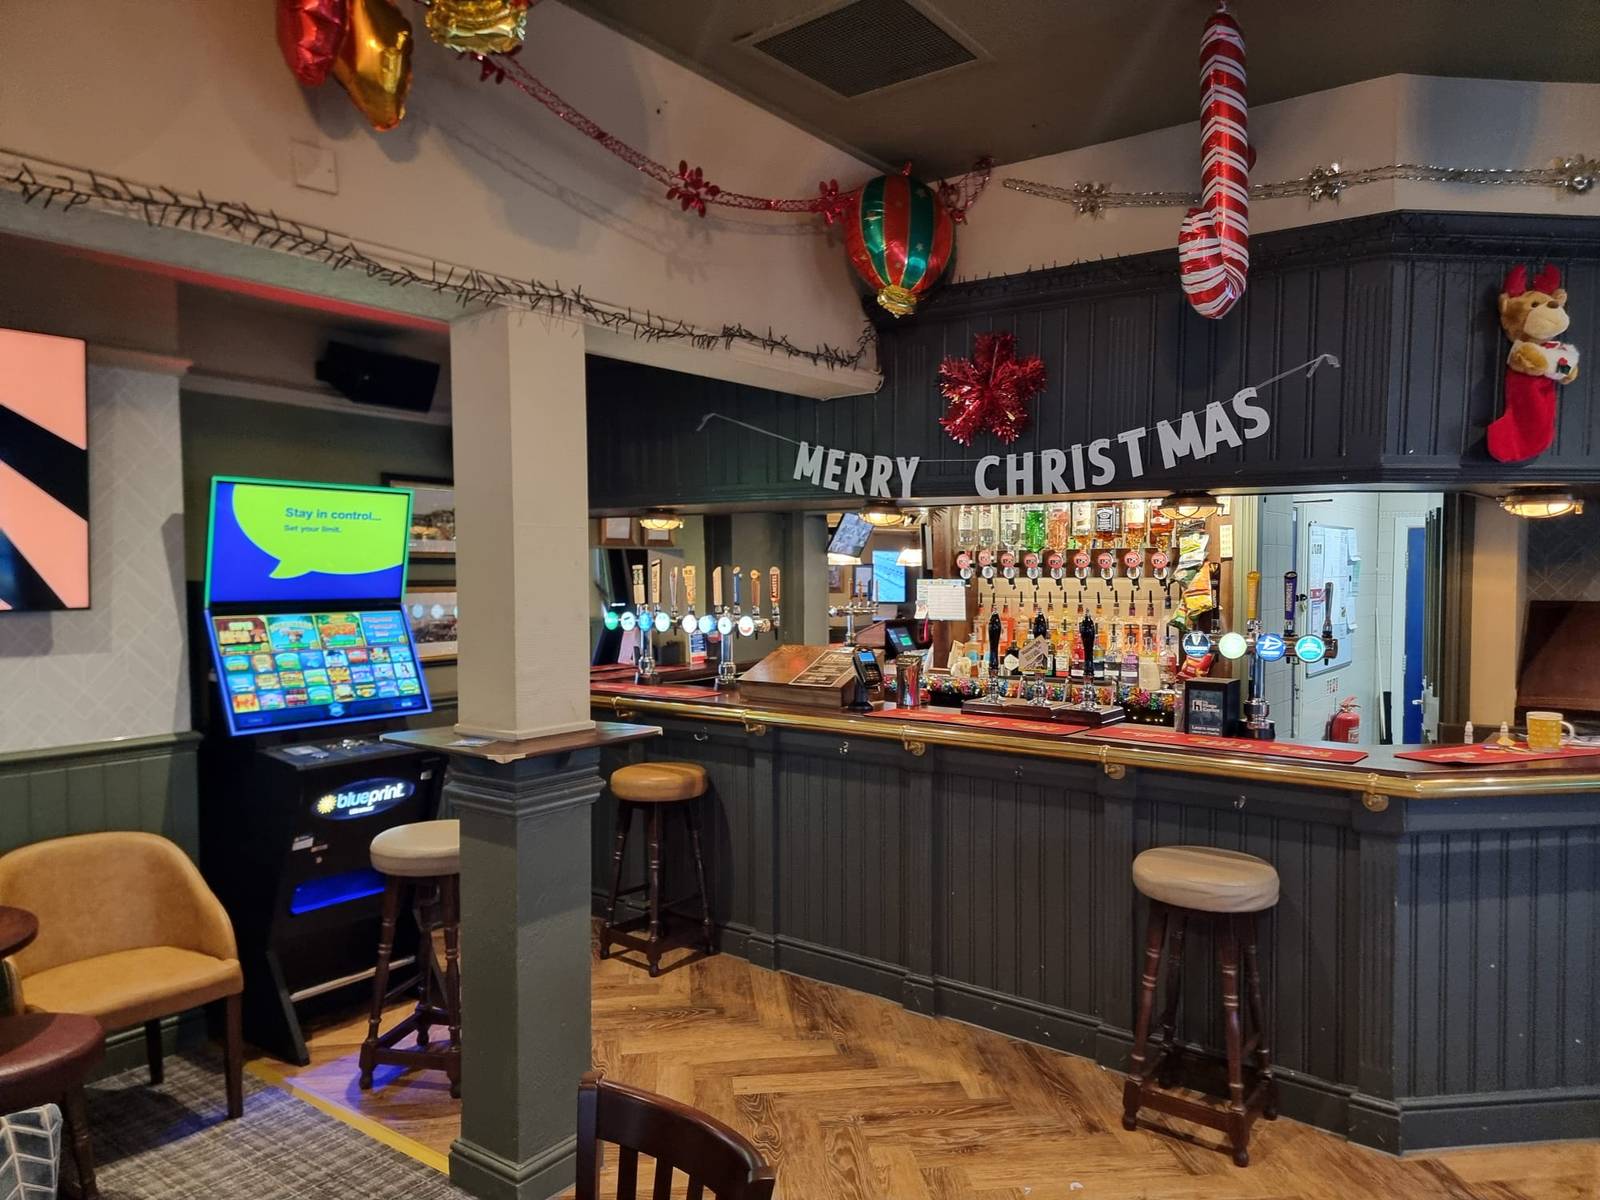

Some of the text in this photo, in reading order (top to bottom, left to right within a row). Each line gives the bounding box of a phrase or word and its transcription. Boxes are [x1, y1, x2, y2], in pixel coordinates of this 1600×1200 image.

[793, 387, 1271, 499] MERRY CHRISTMAS
[286, 507, 381, 521] Stay in control...
[301, 526, 320, 534] your
[336, 782, 406, 807] blueprint
